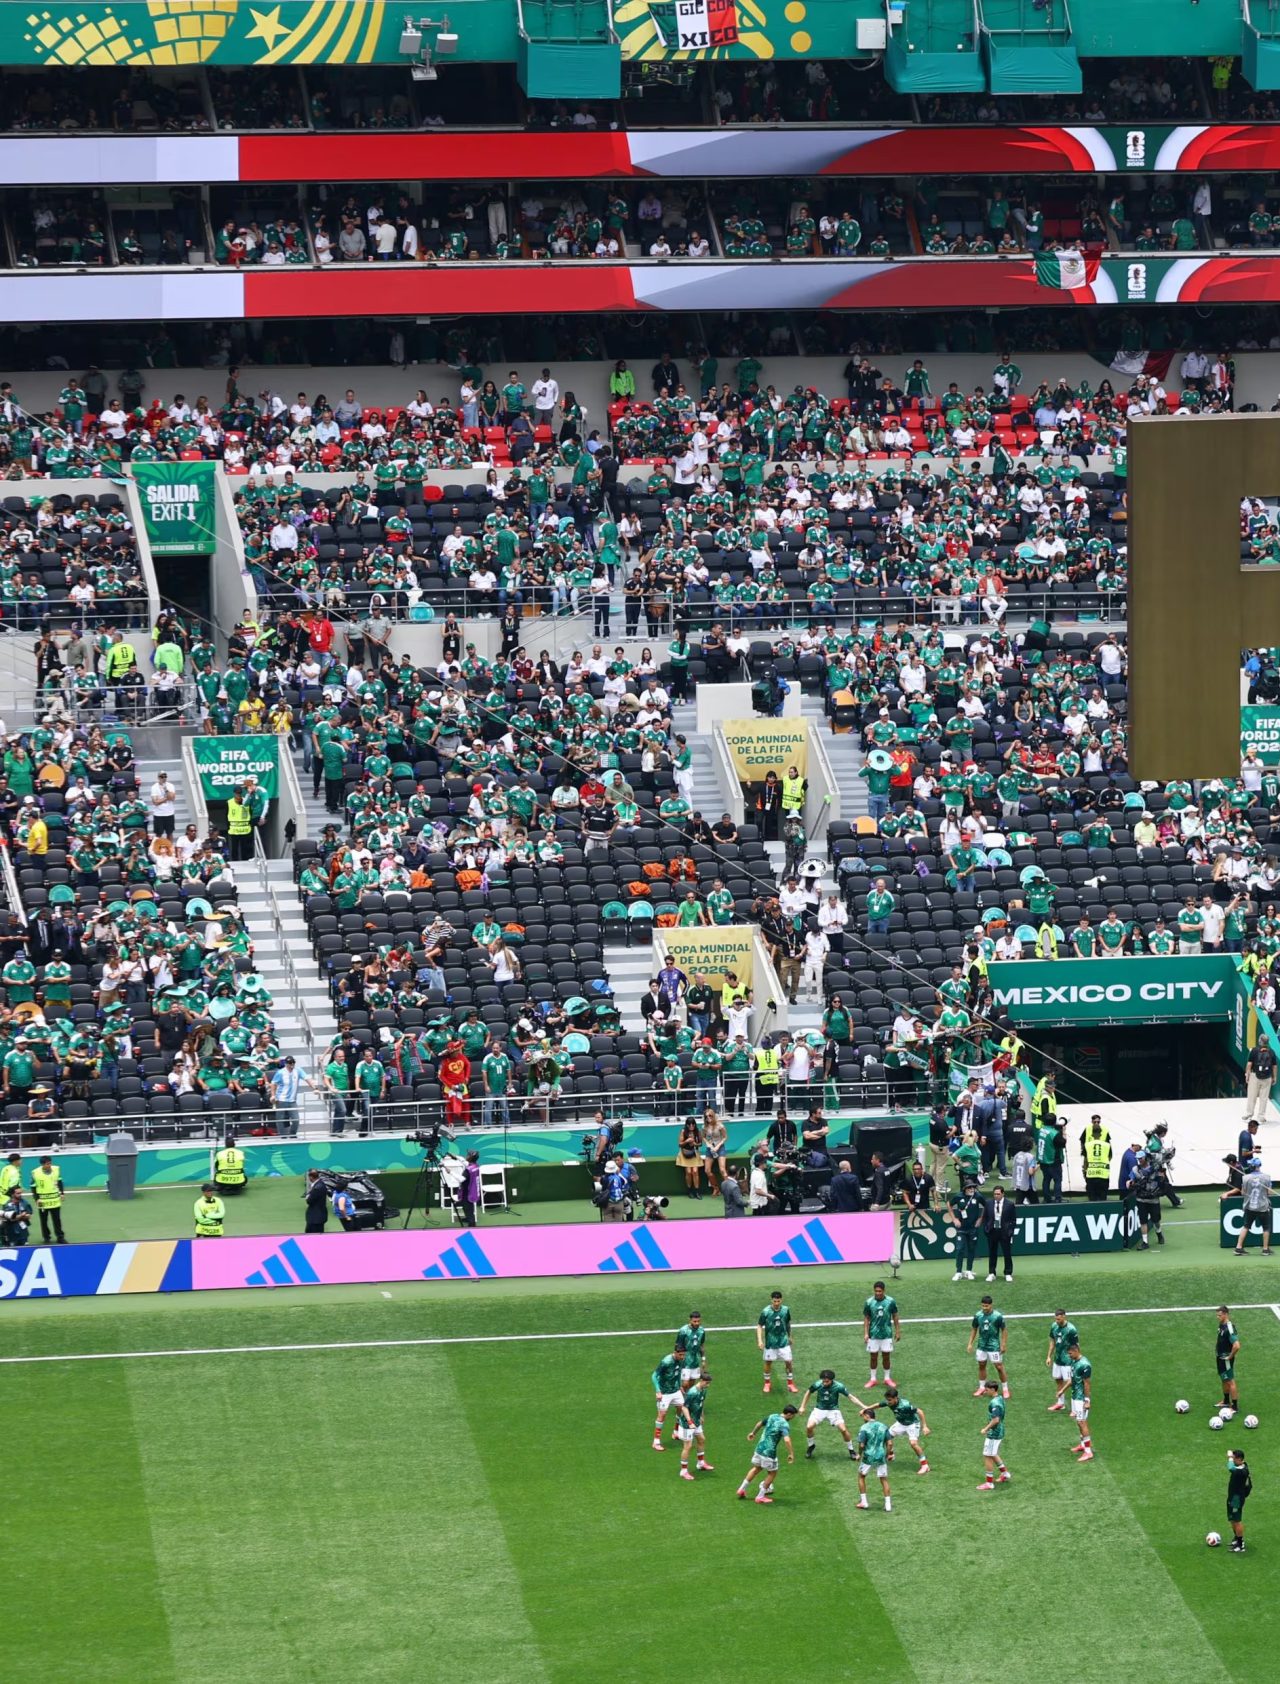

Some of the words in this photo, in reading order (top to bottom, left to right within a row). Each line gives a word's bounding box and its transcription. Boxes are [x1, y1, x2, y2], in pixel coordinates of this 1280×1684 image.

[667, 26, 738, 47] EXICO
[147, 484, 200, 503] SALIDA
[152, 503, 184, 521] EXIT
[186, 503, 196, 520] 1
[726, 736, 753, 745] COPA
[757, 734, 804, 744] MUNDIAL
[738, 746, 752, 754] DE
[754, 745, 766, 754] LA
[770, 745, 792, 753] FIFA
[220, 750, 250, 761] FIFA
[746, 755, 784, 764] 2026
[197, 763, 246, 773] WORLD
[247, 761, 274, 772] CUP
[1265, 783, 1277, 797] 10
[667, 945, 697, 954] COPA
[700, 943, 750, 953] MUNDIAL
[680, 956, 693, 964] DE
[697, 955, 711, 964] LA
[714, 954, 737, 963] FIFA
[688, 965, 729, 975] 2026
[993, 984, 1131, 1005] MEXICO
[1139, 980, 1223, 1000] CITY
